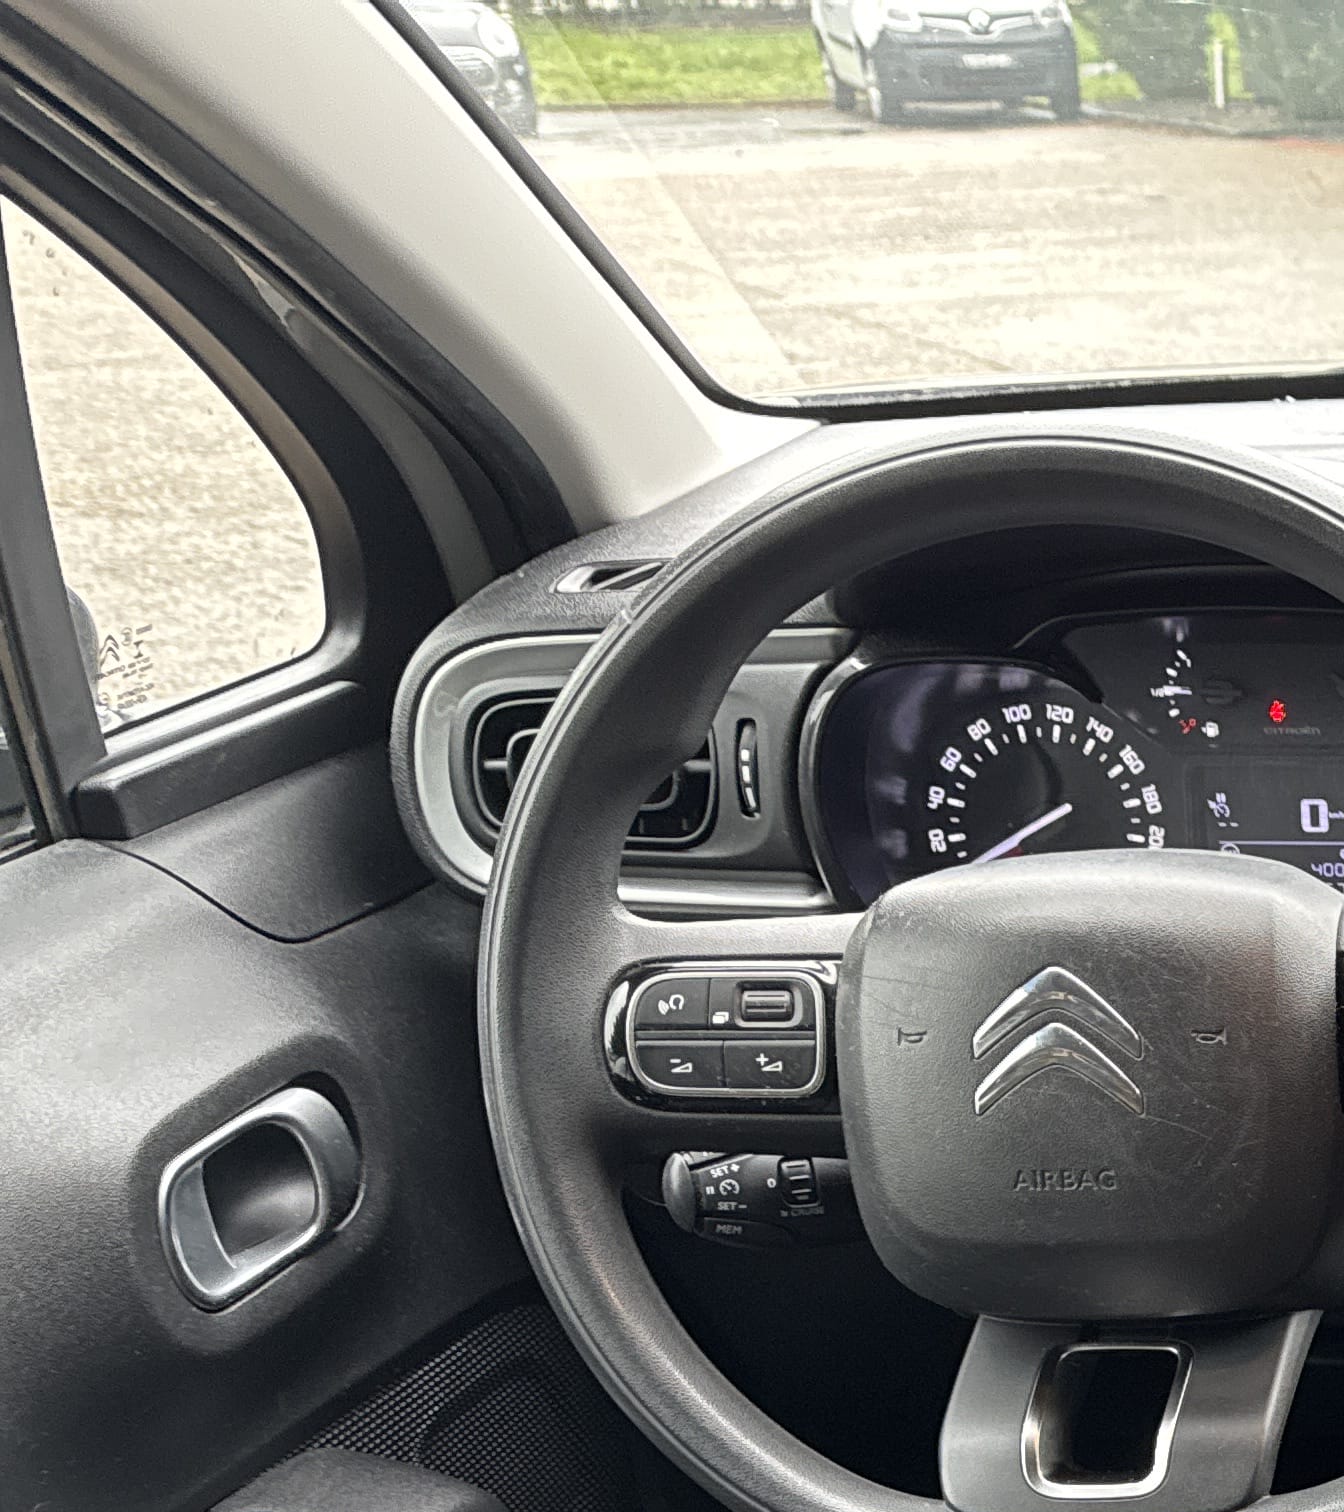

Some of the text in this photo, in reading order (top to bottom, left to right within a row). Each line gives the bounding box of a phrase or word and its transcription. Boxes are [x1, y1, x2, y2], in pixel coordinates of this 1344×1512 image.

[1002, 703, 1032, 724] 100
[1045, 703, 1075, 724] 120
[966, 718, 992, 742] 80
[1085, 716, 1114, 744] 140
[939, 746, 962, 772] 60
[1118, 744, 1146, 776] 160
[927, 786, 946, 810] 40
[1140, 783, 1163, 815] 180
[1300, 799, 1329, 833] 0
[928, 829, 947, 853] 20
[1012, 1168, 1120, 1193] AIRBAG
[717, 1201, 738, 1211] SET
[715, 1224, 742, 1234] MEM
